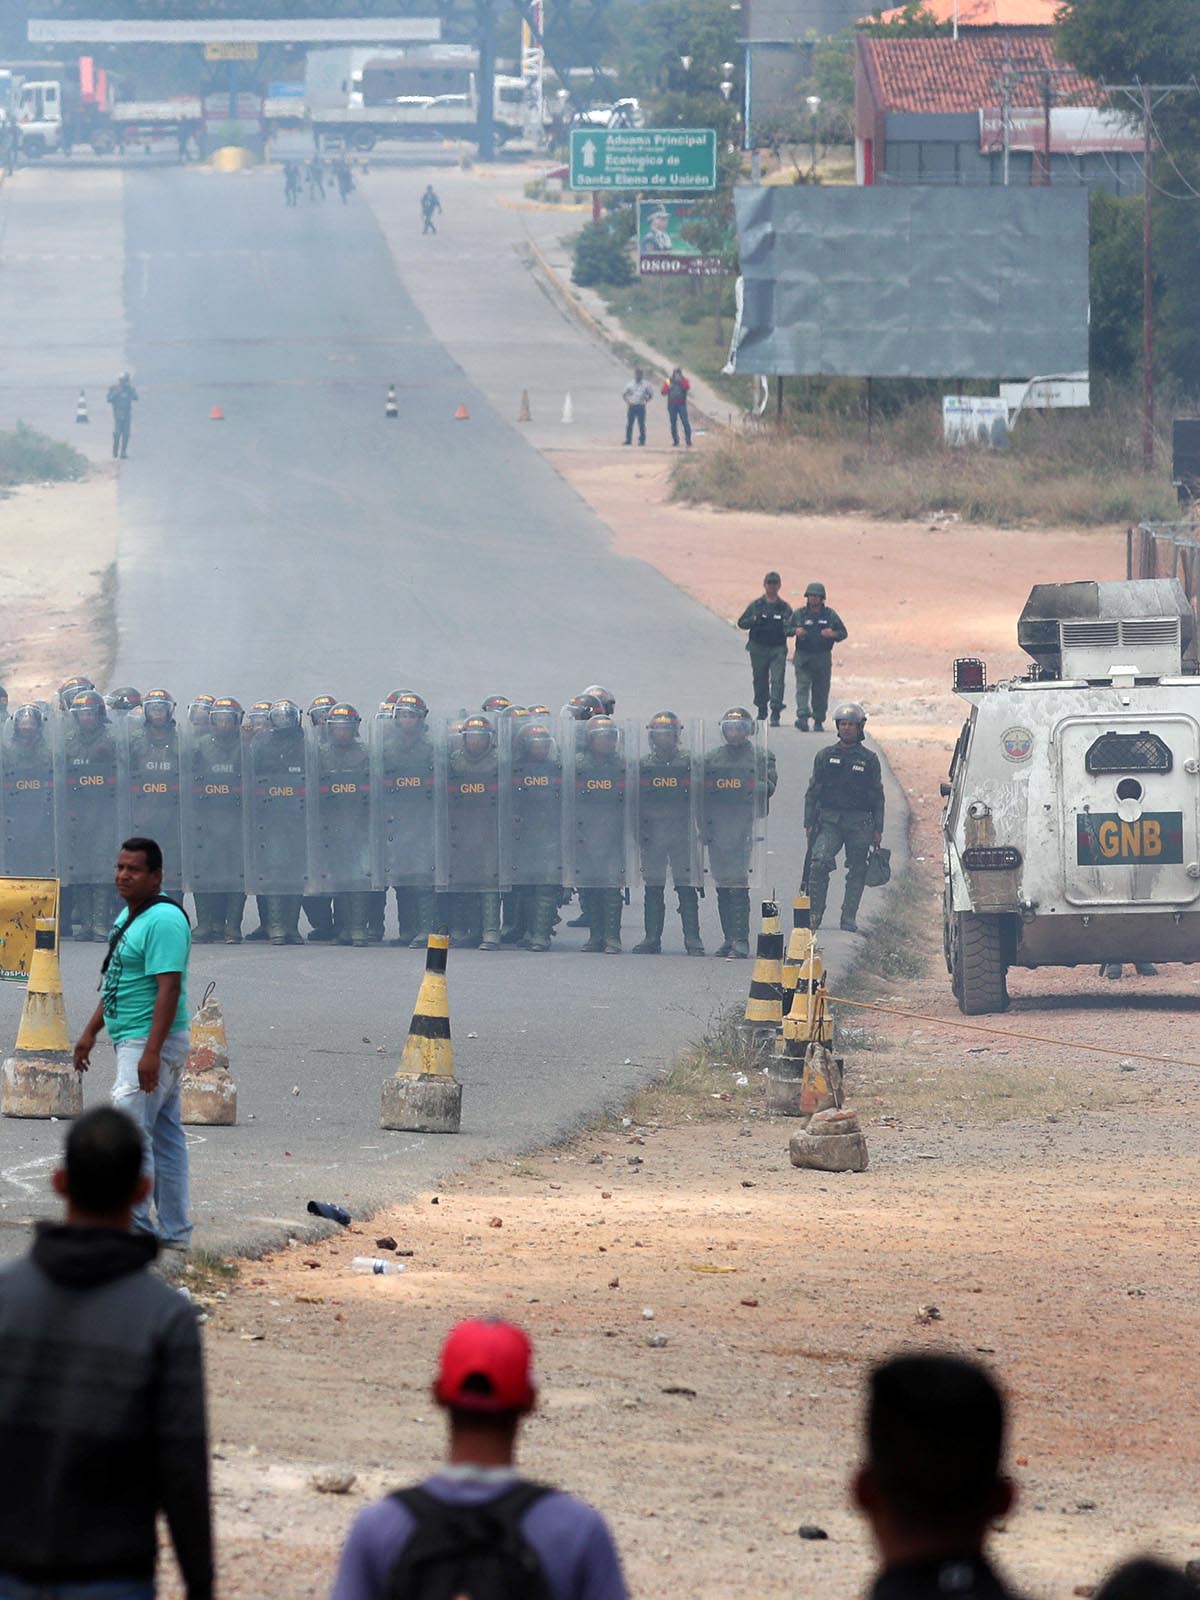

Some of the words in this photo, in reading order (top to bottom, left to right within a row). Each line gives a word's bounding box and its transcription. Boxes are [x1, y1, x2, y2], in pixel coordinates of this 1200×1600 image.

[606, 135, 650, 146] Aduana
[654, 134, 707, 147] Principal
[667, 155, 680, 166] de
[577, 174, 611, 185] Santa
[615, 174, 648, 185] Elena
[651, 174, 666, 185] de
[16, 780, 41, 790] GNB
[79, 775, 104, 785] GNB
[396, 777, 421, 787] GNB
[524, 776, 549, 786] GNB
[586, 779, 612, 790] GNB
[652, 777, 678, 787] GNB
[716, 778, 742, 788] GNB
[143, 783, 167, 793] GNB
[205, 784, 230, 794] GNB
[269, 786, 294, 796] GNB
[331, 783, 356, 793] GNB
[460, 783, 485, 793] GNB
[1101, 819, 1163, 858] GNB
